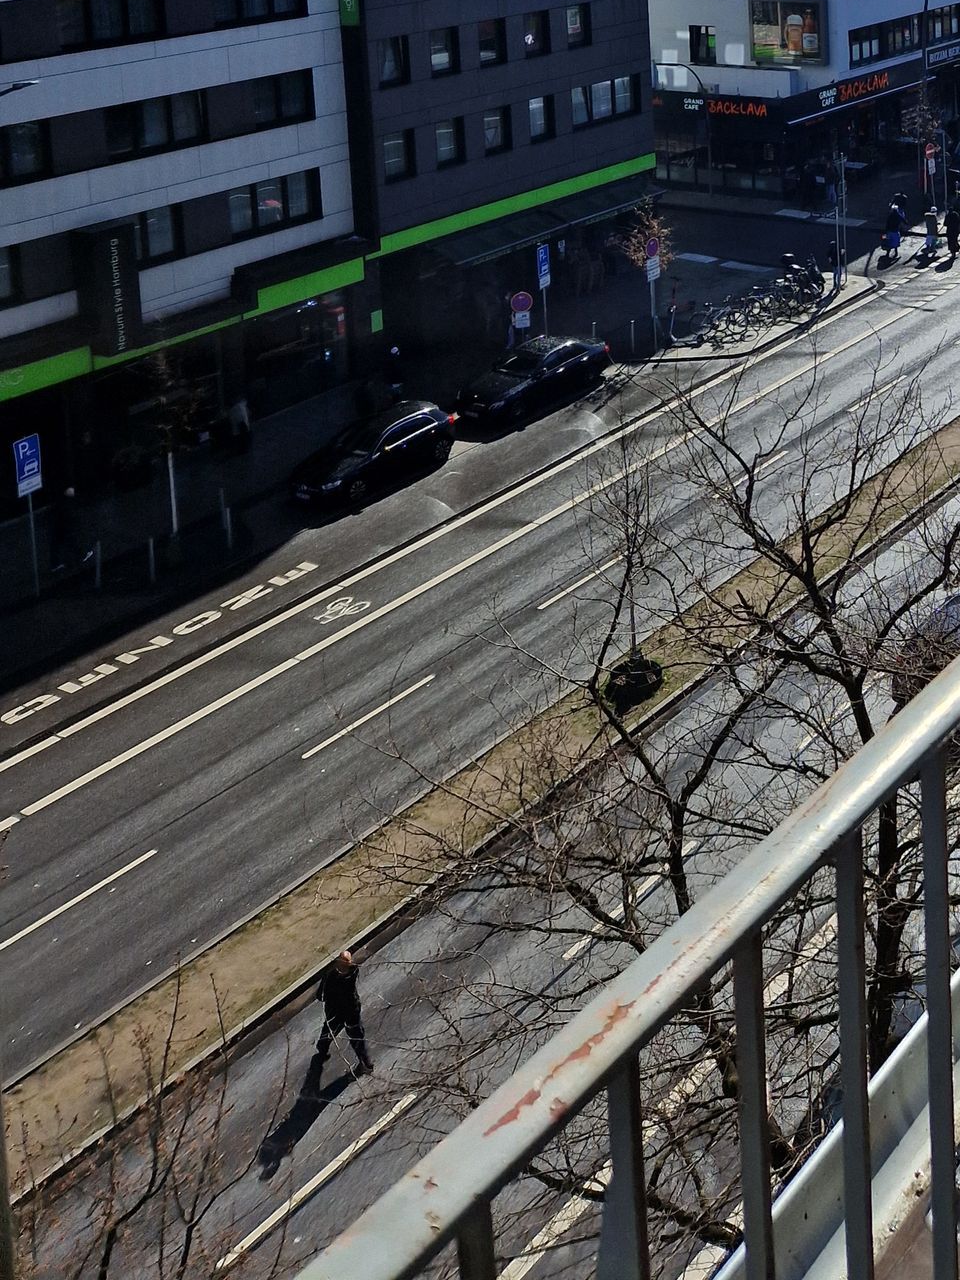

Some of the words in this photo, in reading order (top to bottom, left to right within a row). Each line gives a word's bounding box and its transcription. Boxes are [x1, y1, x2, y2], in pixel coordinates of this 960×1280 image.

[684, 97, 704, 105] GRAND
[819, 87, 837, 100] GRAND
[110, 238, 120, 287] Hamburg
[114, 288, 123, 312] Style
[116, 313, 126, 351] Novum
[18, 442, 29, 459] P
